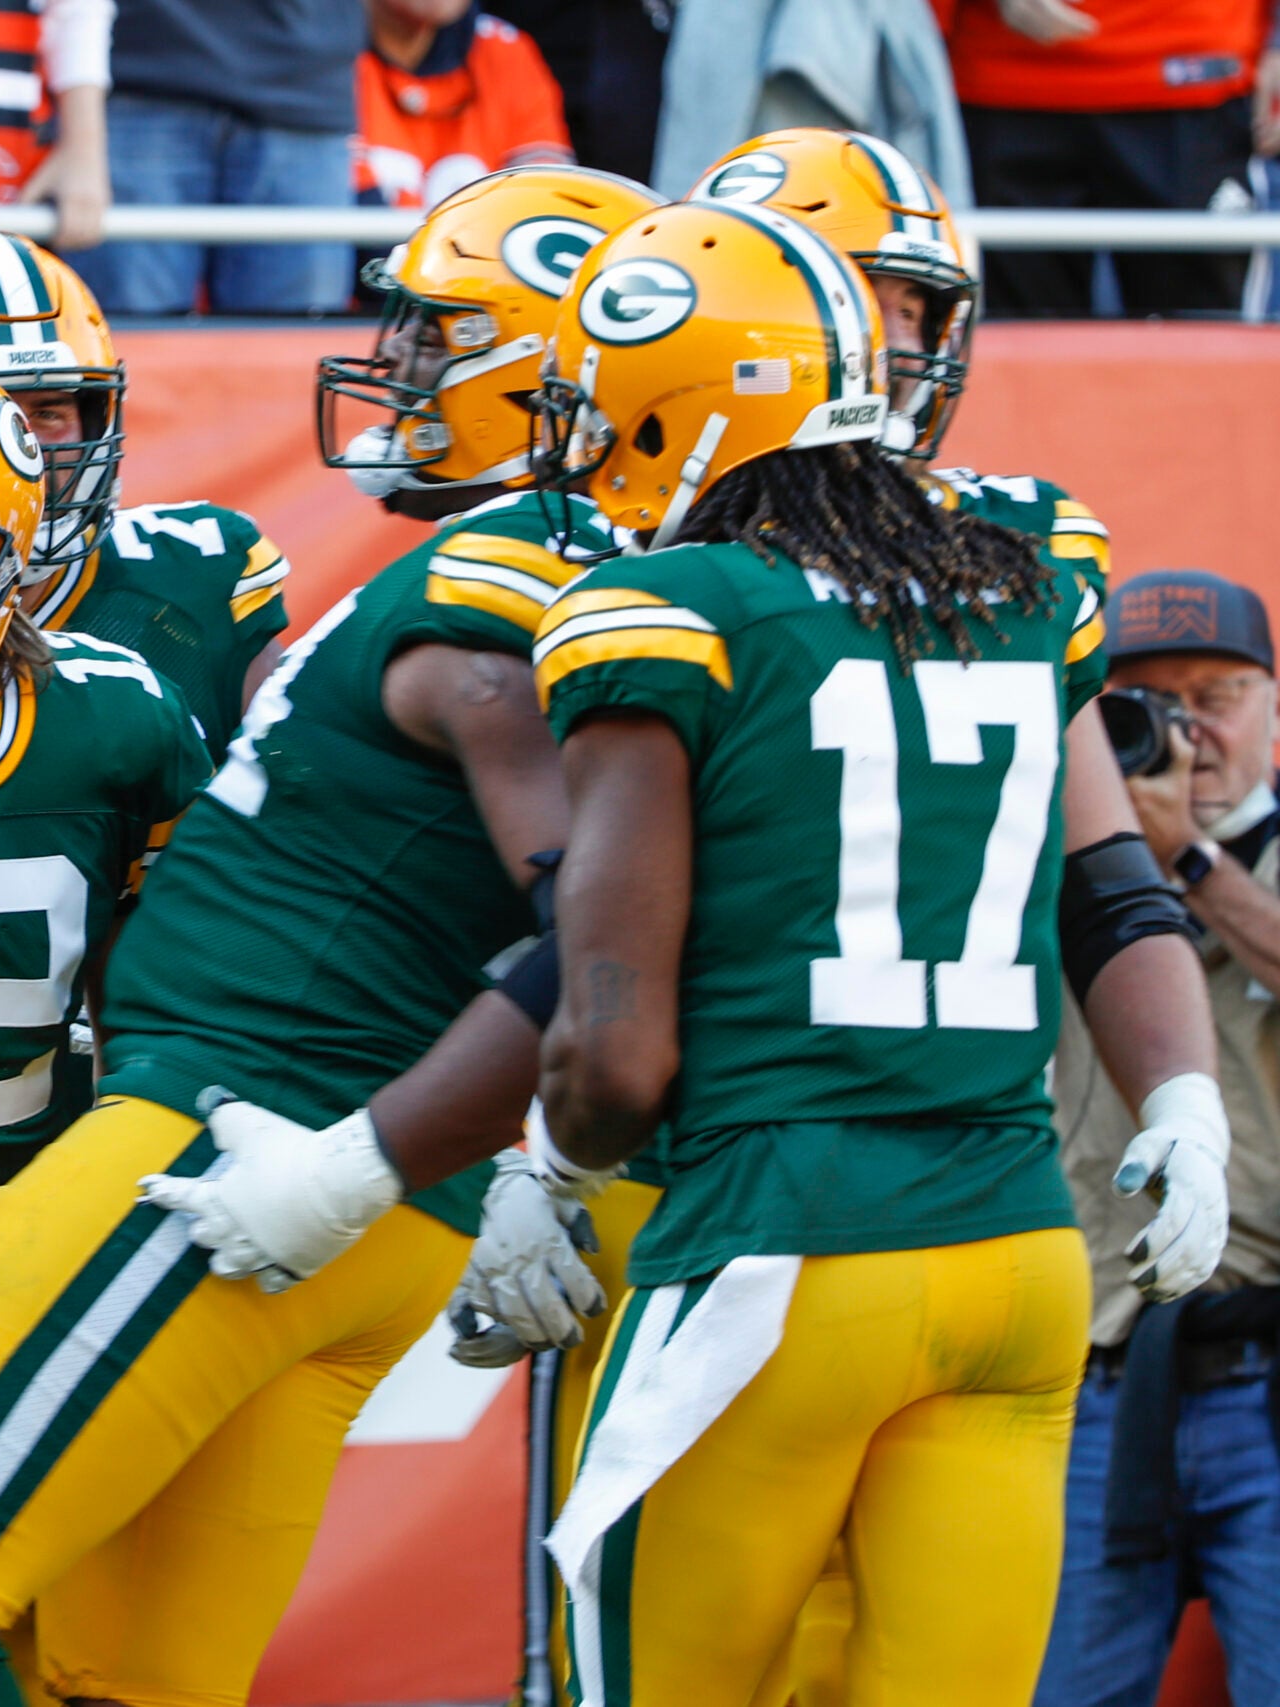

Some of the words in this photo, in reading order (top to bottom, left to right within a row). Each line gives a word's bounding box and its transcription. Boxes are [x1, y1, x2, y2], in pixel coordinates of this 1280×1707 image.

[687, 152, 785, 204] G
[579, 260, 694, 342] G
[809, 657, 1060, 1031] 17
